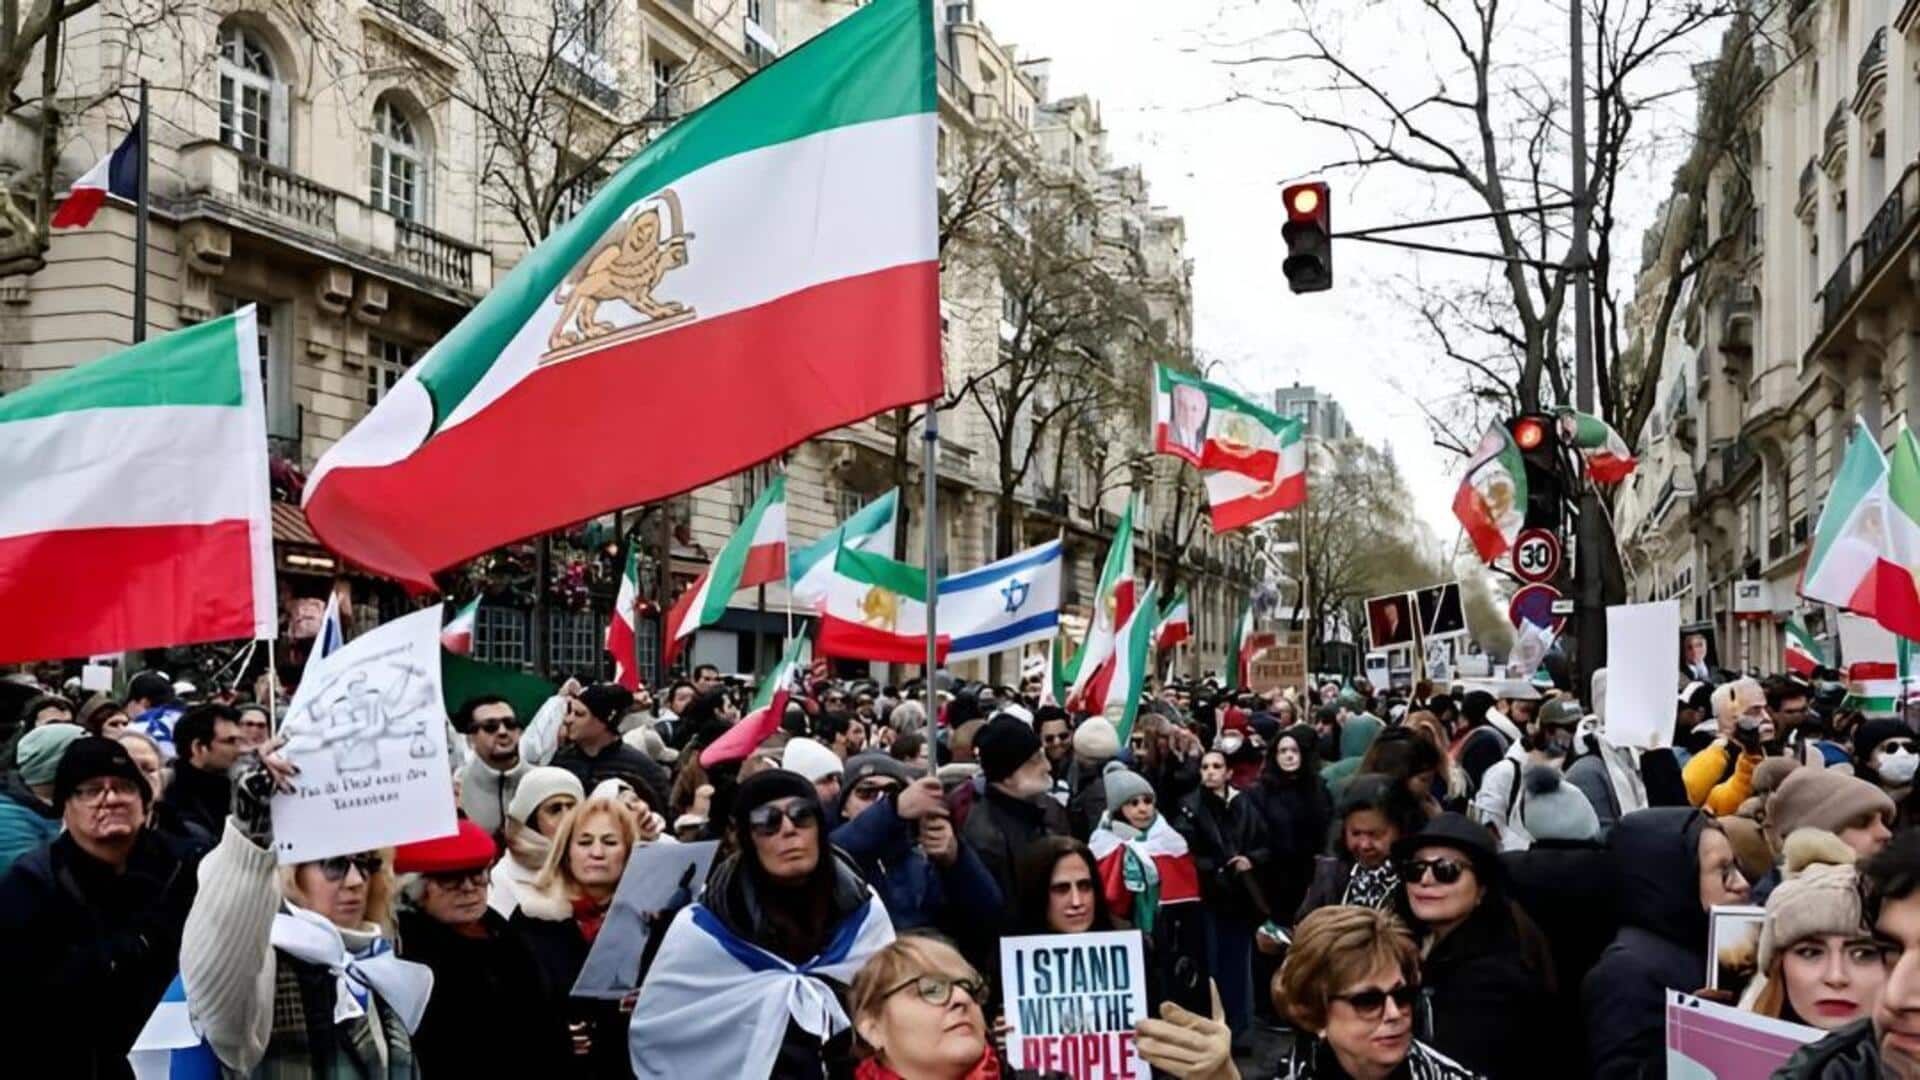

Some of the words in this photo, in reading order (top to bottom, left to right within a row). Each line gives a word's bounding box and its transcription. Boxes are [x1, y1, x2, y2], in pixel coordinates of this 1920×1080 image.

[1521, 543, 1549, 568] 30
[1015, 950, 1025, 996] I
[1033, 944, 1130, 995] STAND
[1018, 996, 1085, 1035] WITH
[1089, 994, 1135, 1033] THE
[1022, 1032, 1137, 1080] PEOPLE
